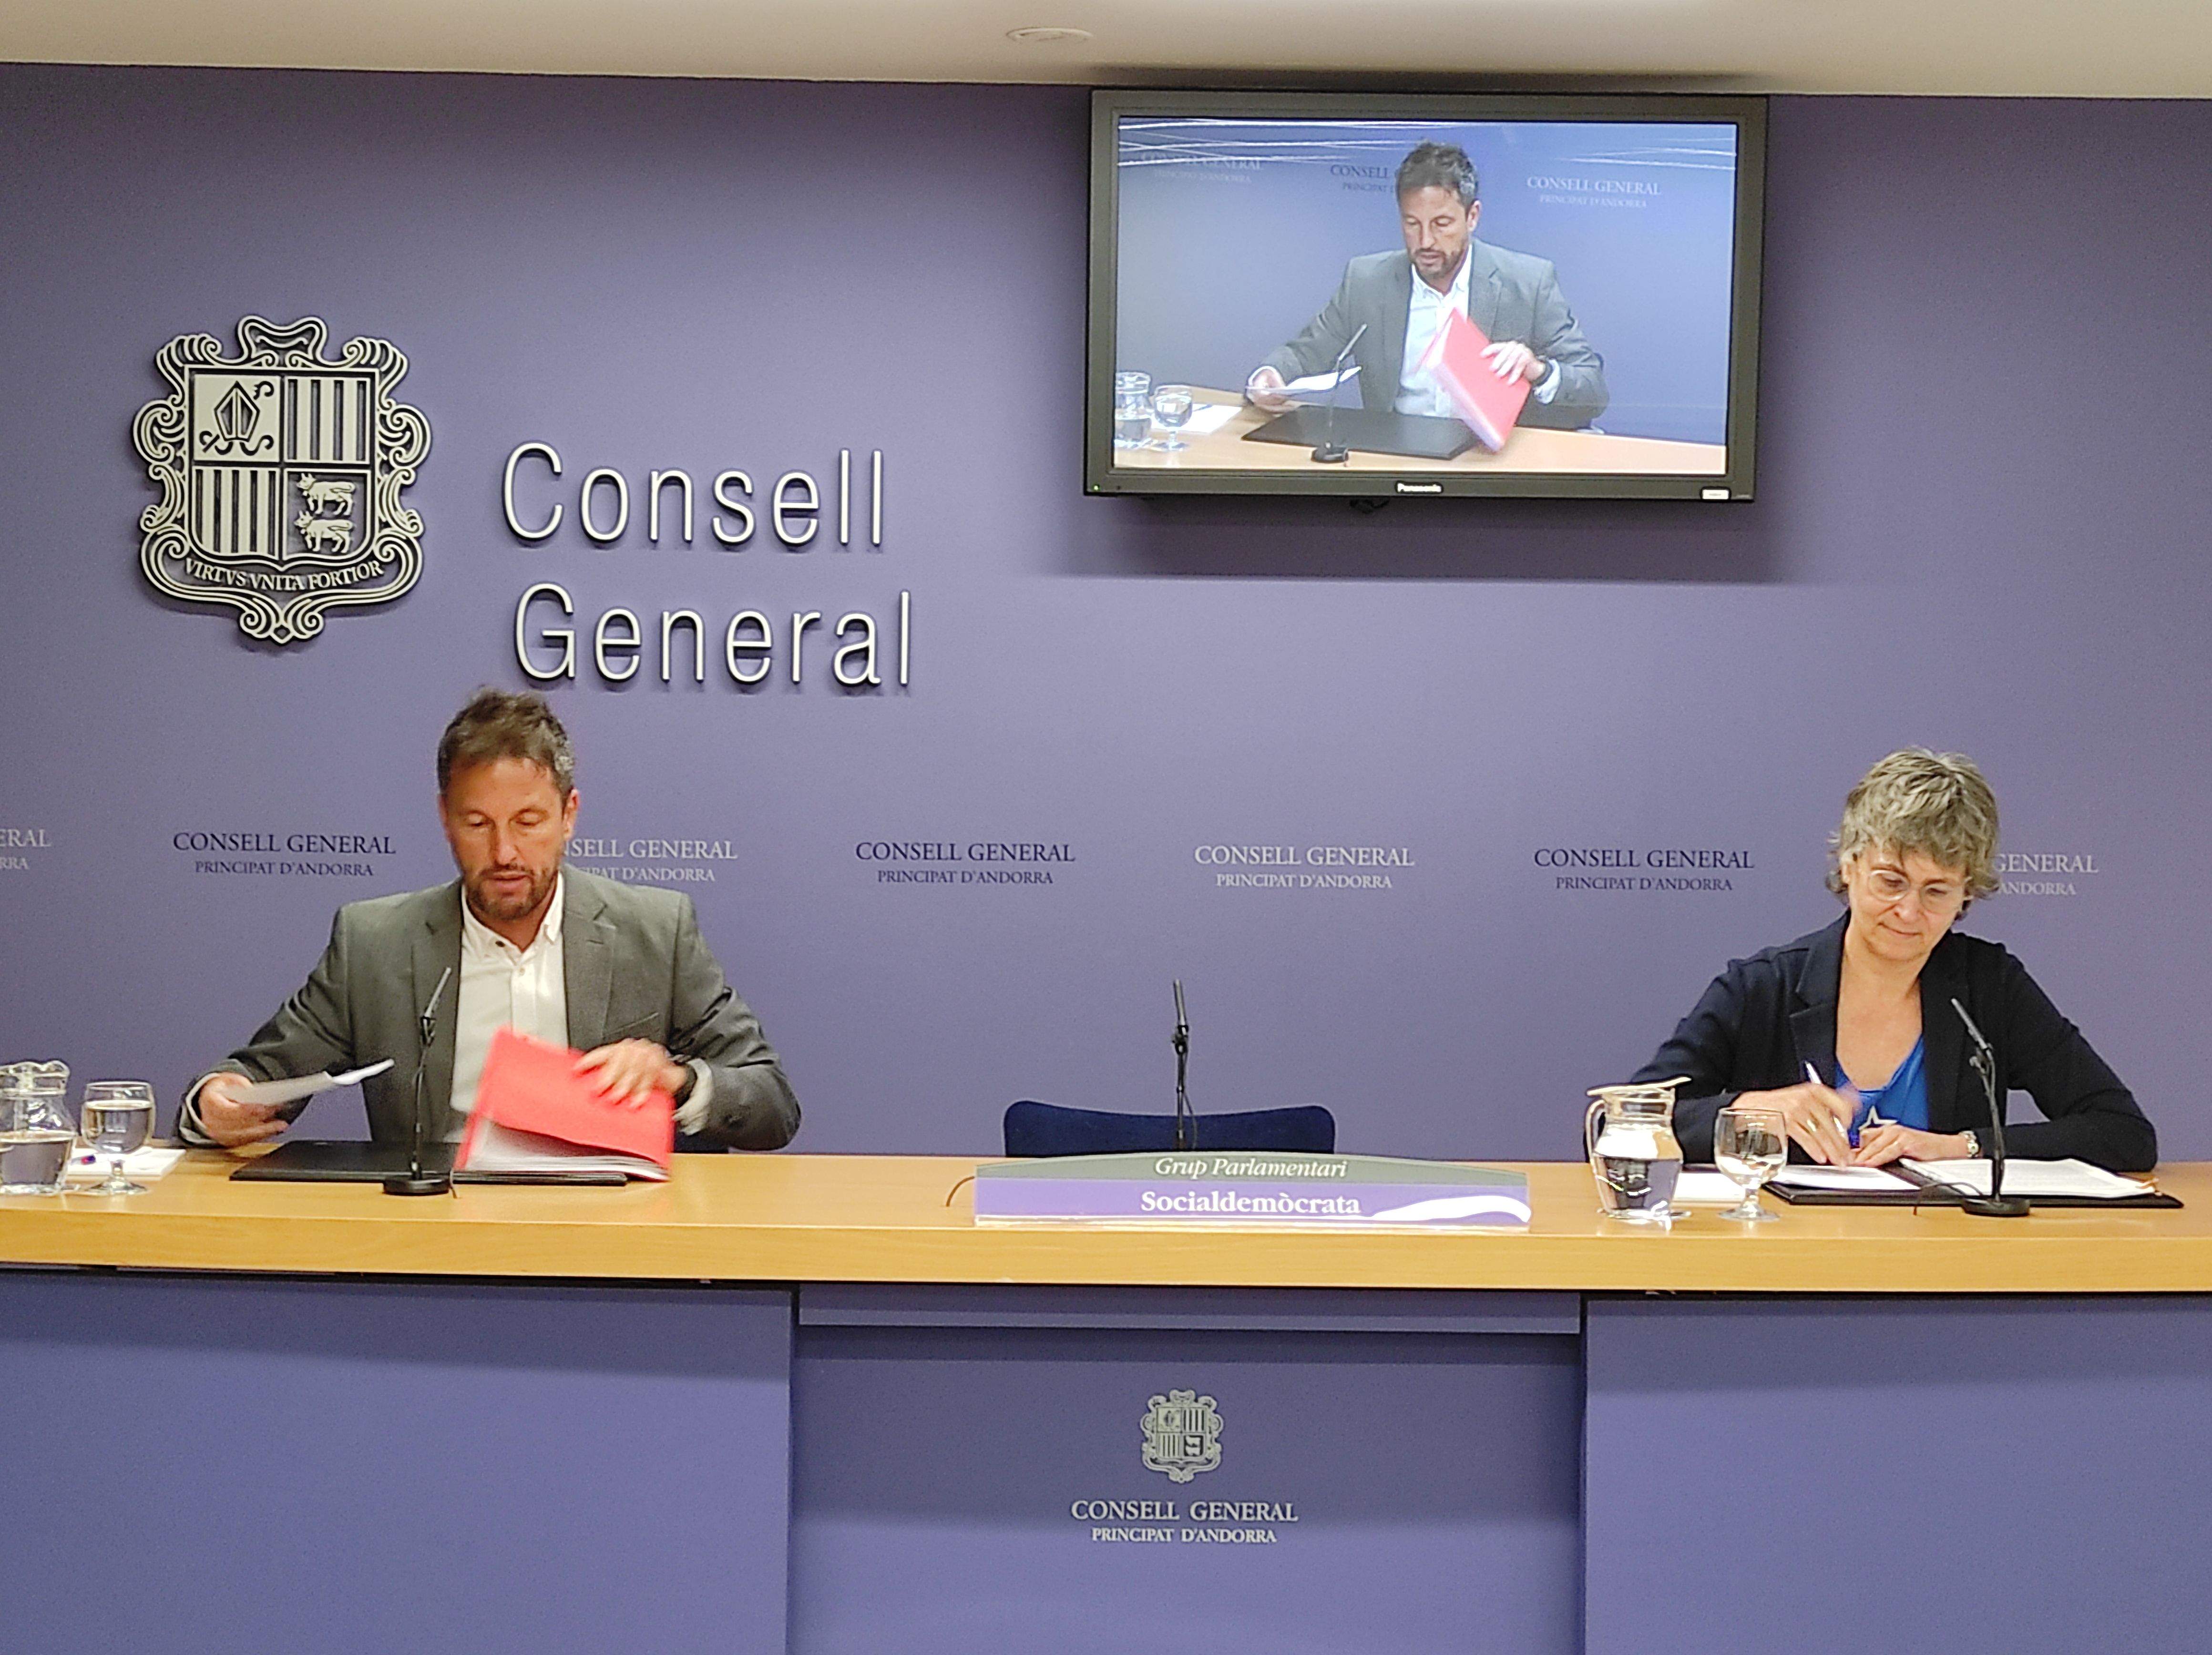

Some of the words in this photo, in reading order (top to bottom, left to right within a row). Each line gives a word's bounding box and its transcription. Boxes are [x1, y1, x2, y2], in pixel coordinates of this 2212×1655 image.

[1527, 176, 1593, 192] CONSELL
[1595, 180, 1662, 195] GENERAL
[502, 440, 883, 547] Consell
[184, 557, 247, 587] VIRTVS
[248, 573, 306, 591] VNITA
[307, 560, 385, 591] FORTIOR
[514, 582, 911, 686] General
[0, 828, 52, 847] ERAL
[174, 832, 281, 852] CONSELL
[287, 834, 396, 855] GENERAL
[564, 838, 624, 858] SELL
[629, 839, 738, 859] GENERAL
[856, 842, 962, 861] CONSELL
[968, 843, 1076, 862] GENERAL
[1194, 846, 1301, 866] CONSELL
[1306, 847, 1414, 866] GENERAL
[1534, 849, 1640, 867] CONSELL
[1647, 850, 1754, 868] GENERAL
[196, 861, 276, 875] PRINCIPAT
[280, 862, 374, 876] D'ANDORRA
[622, 867, 716, 882] D'ANDORRA
[878, 870, 957, 883] PRINCIPAT
[961, 871, 1054, 884] D'ANDORRA
[1217, 873, 1296, 888] PRINCIPAT
[1300, 874, 1393, 889] D'ANDORRA
[1556, 877, 1634, 890] PRINCIPAT
[1639, 878, 1732, 891] D'ANDORRA
[1997, 882, 2076, 895] ANDORRA
[1155, 1158, 1208, 1179] Grup
[1212, 1158, 1348, 1177] Parlamentari
[1141, 1191, 1361, 1214] Socialdemòcrata
[1071, 1501, 1180, 1521] CONSELL
[1189, 1502, 1299, 1522] GENERAL
[1092, 1528, 1174, 1542] PRINCIPAT
[1181, 1528, 1277, 1543] D'ANDORRA
